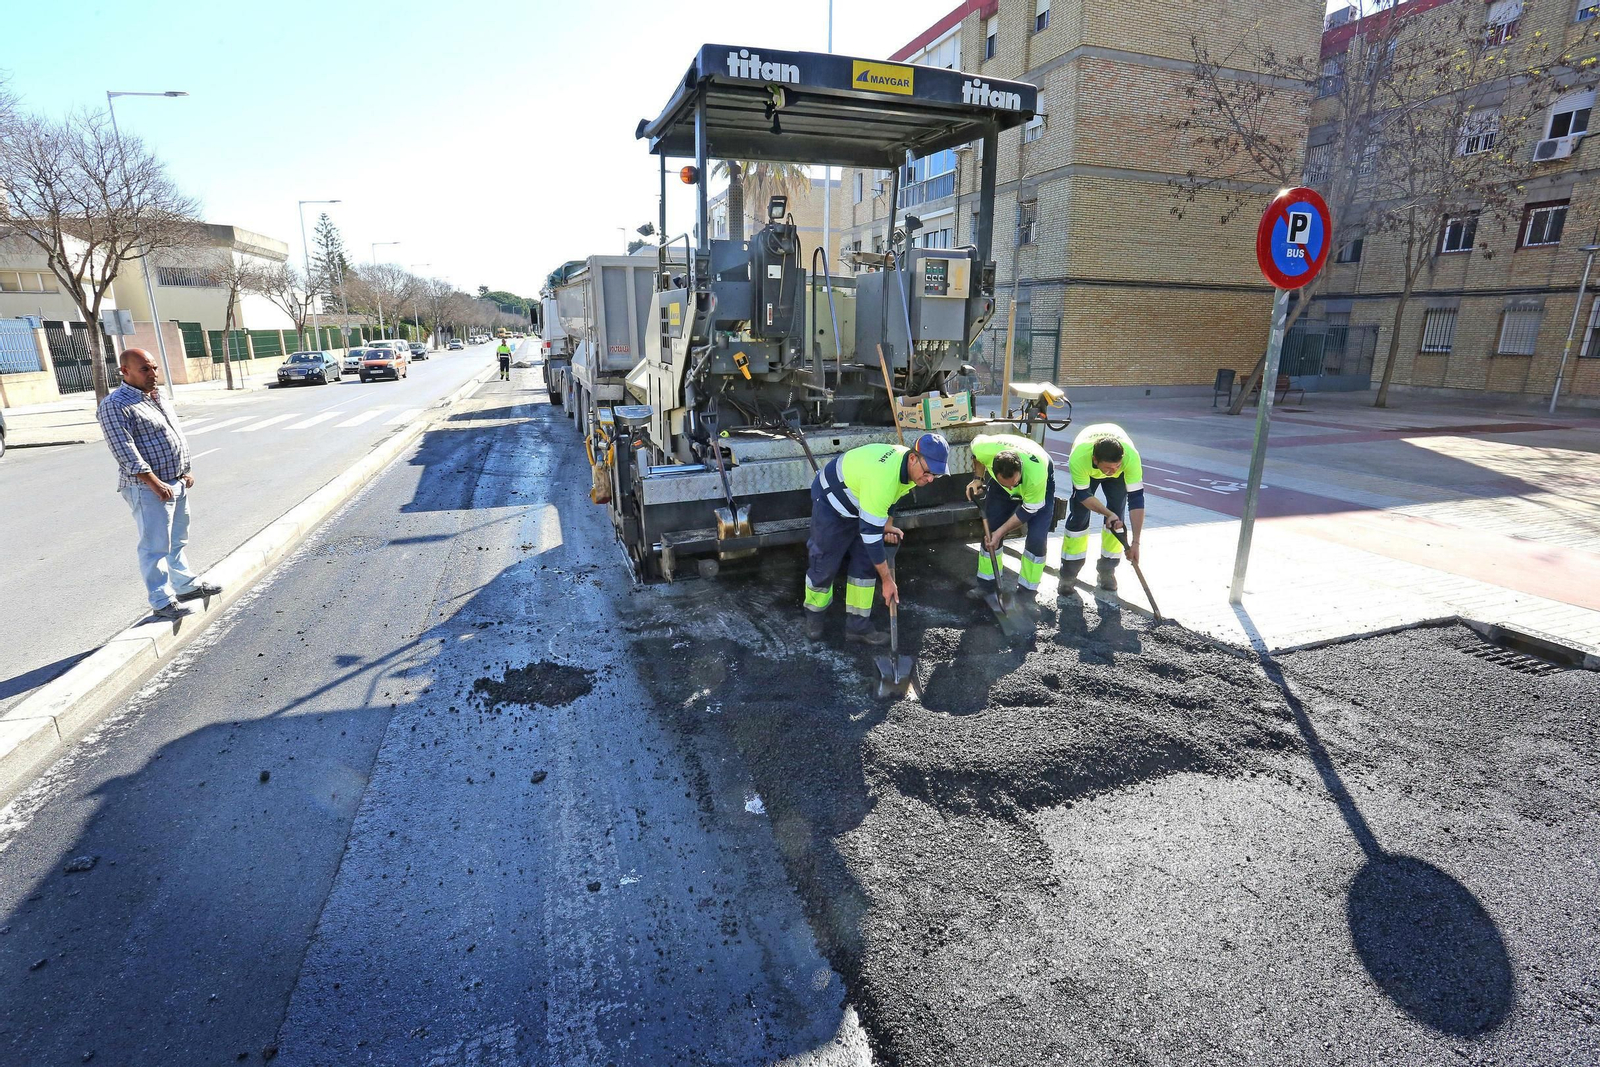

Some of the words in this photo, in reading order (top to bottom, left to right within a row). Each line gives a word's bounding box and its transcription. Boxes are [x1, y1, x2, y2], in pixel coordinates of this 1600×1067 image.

[727, 49, 800, 84] titan
[870, 75, 910, 88] MAYGAR
[962, 78, 1021, 111] titan
[1289, 213, 1308, 242] P
[1286, 248, 1305, 258] BUS
